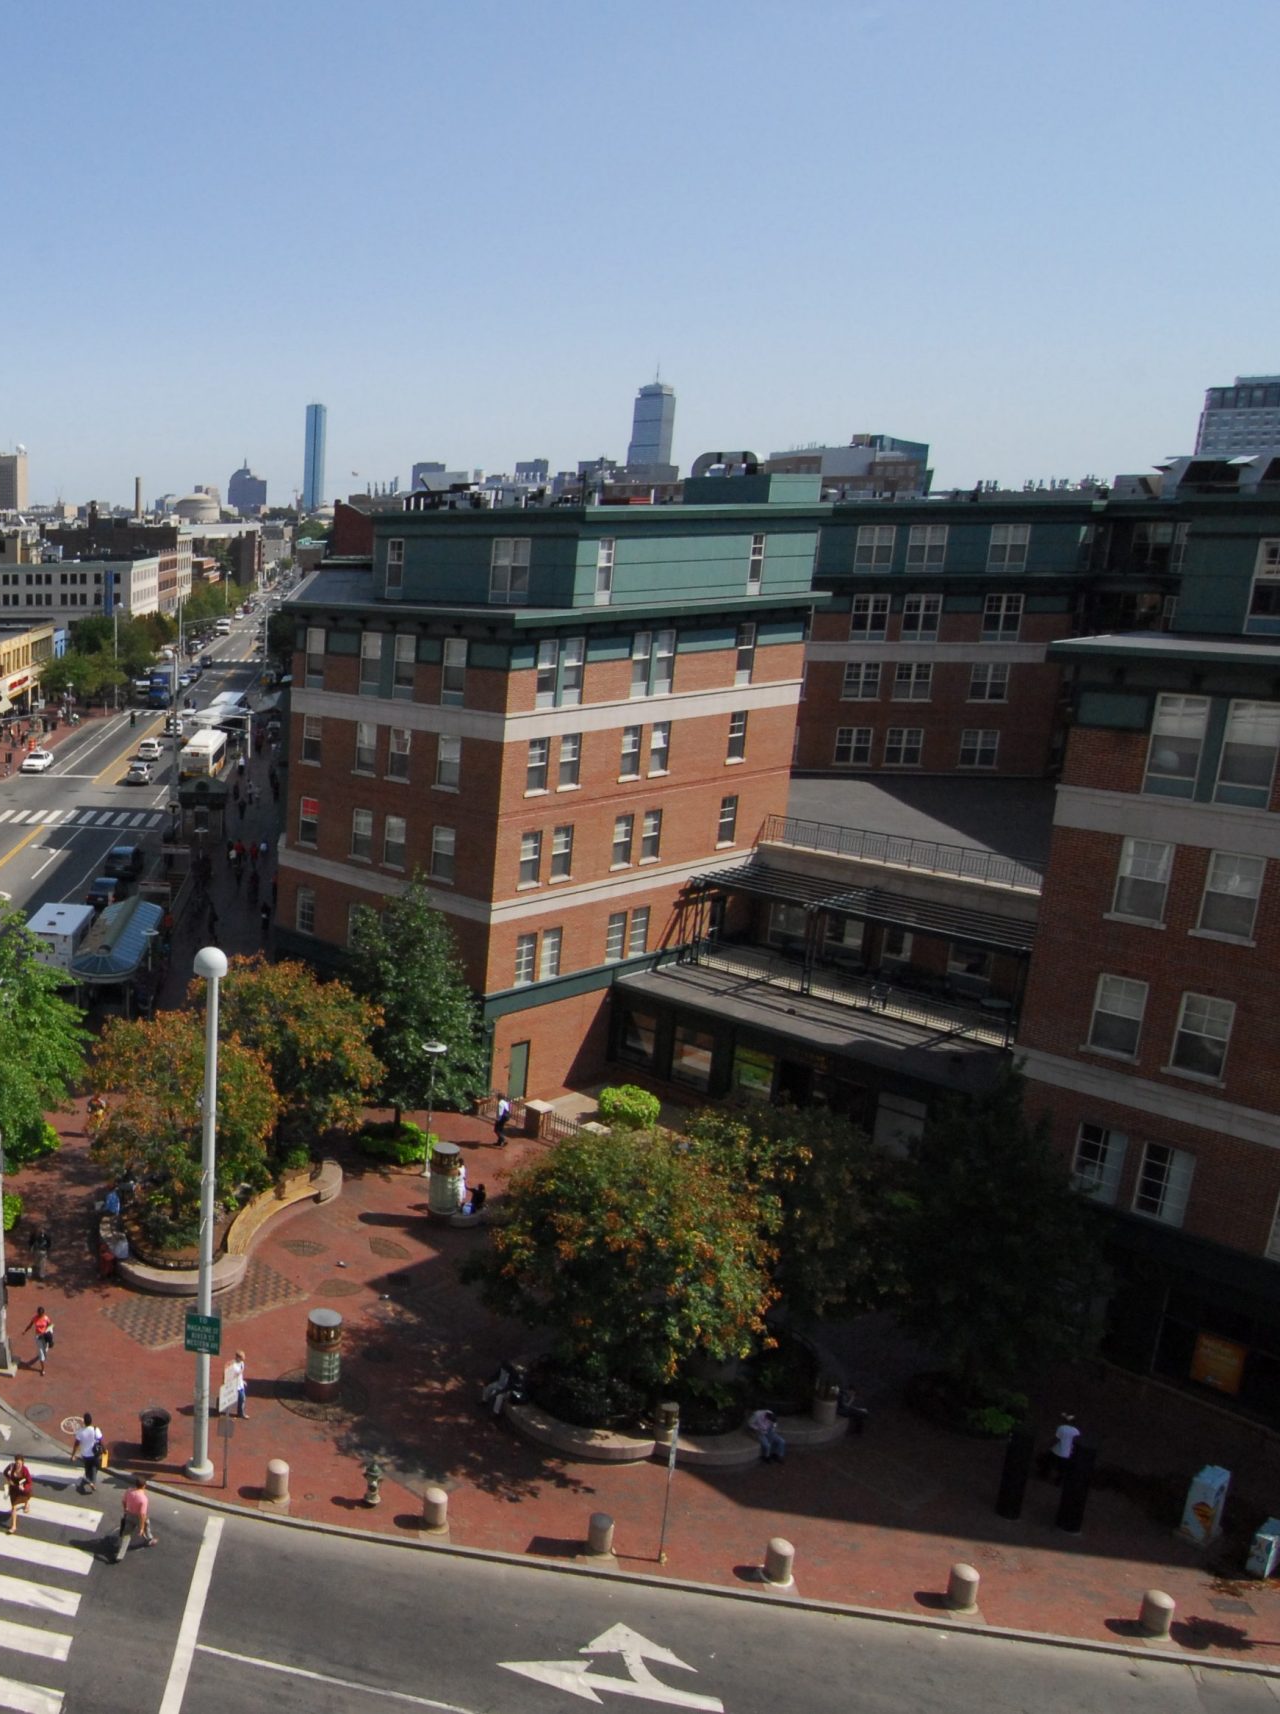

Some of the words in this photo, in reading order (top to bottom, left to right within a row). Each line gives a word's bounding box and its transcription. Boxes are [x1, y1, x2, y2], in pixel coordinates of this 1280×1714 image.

[199, 1316, 209, 1324] TO
[187, 1324, 212, 1334] MAGAZINE
[191, 1332, 208, 1341] RIVER
[187, 1338, 210, 1348] WESTERN
